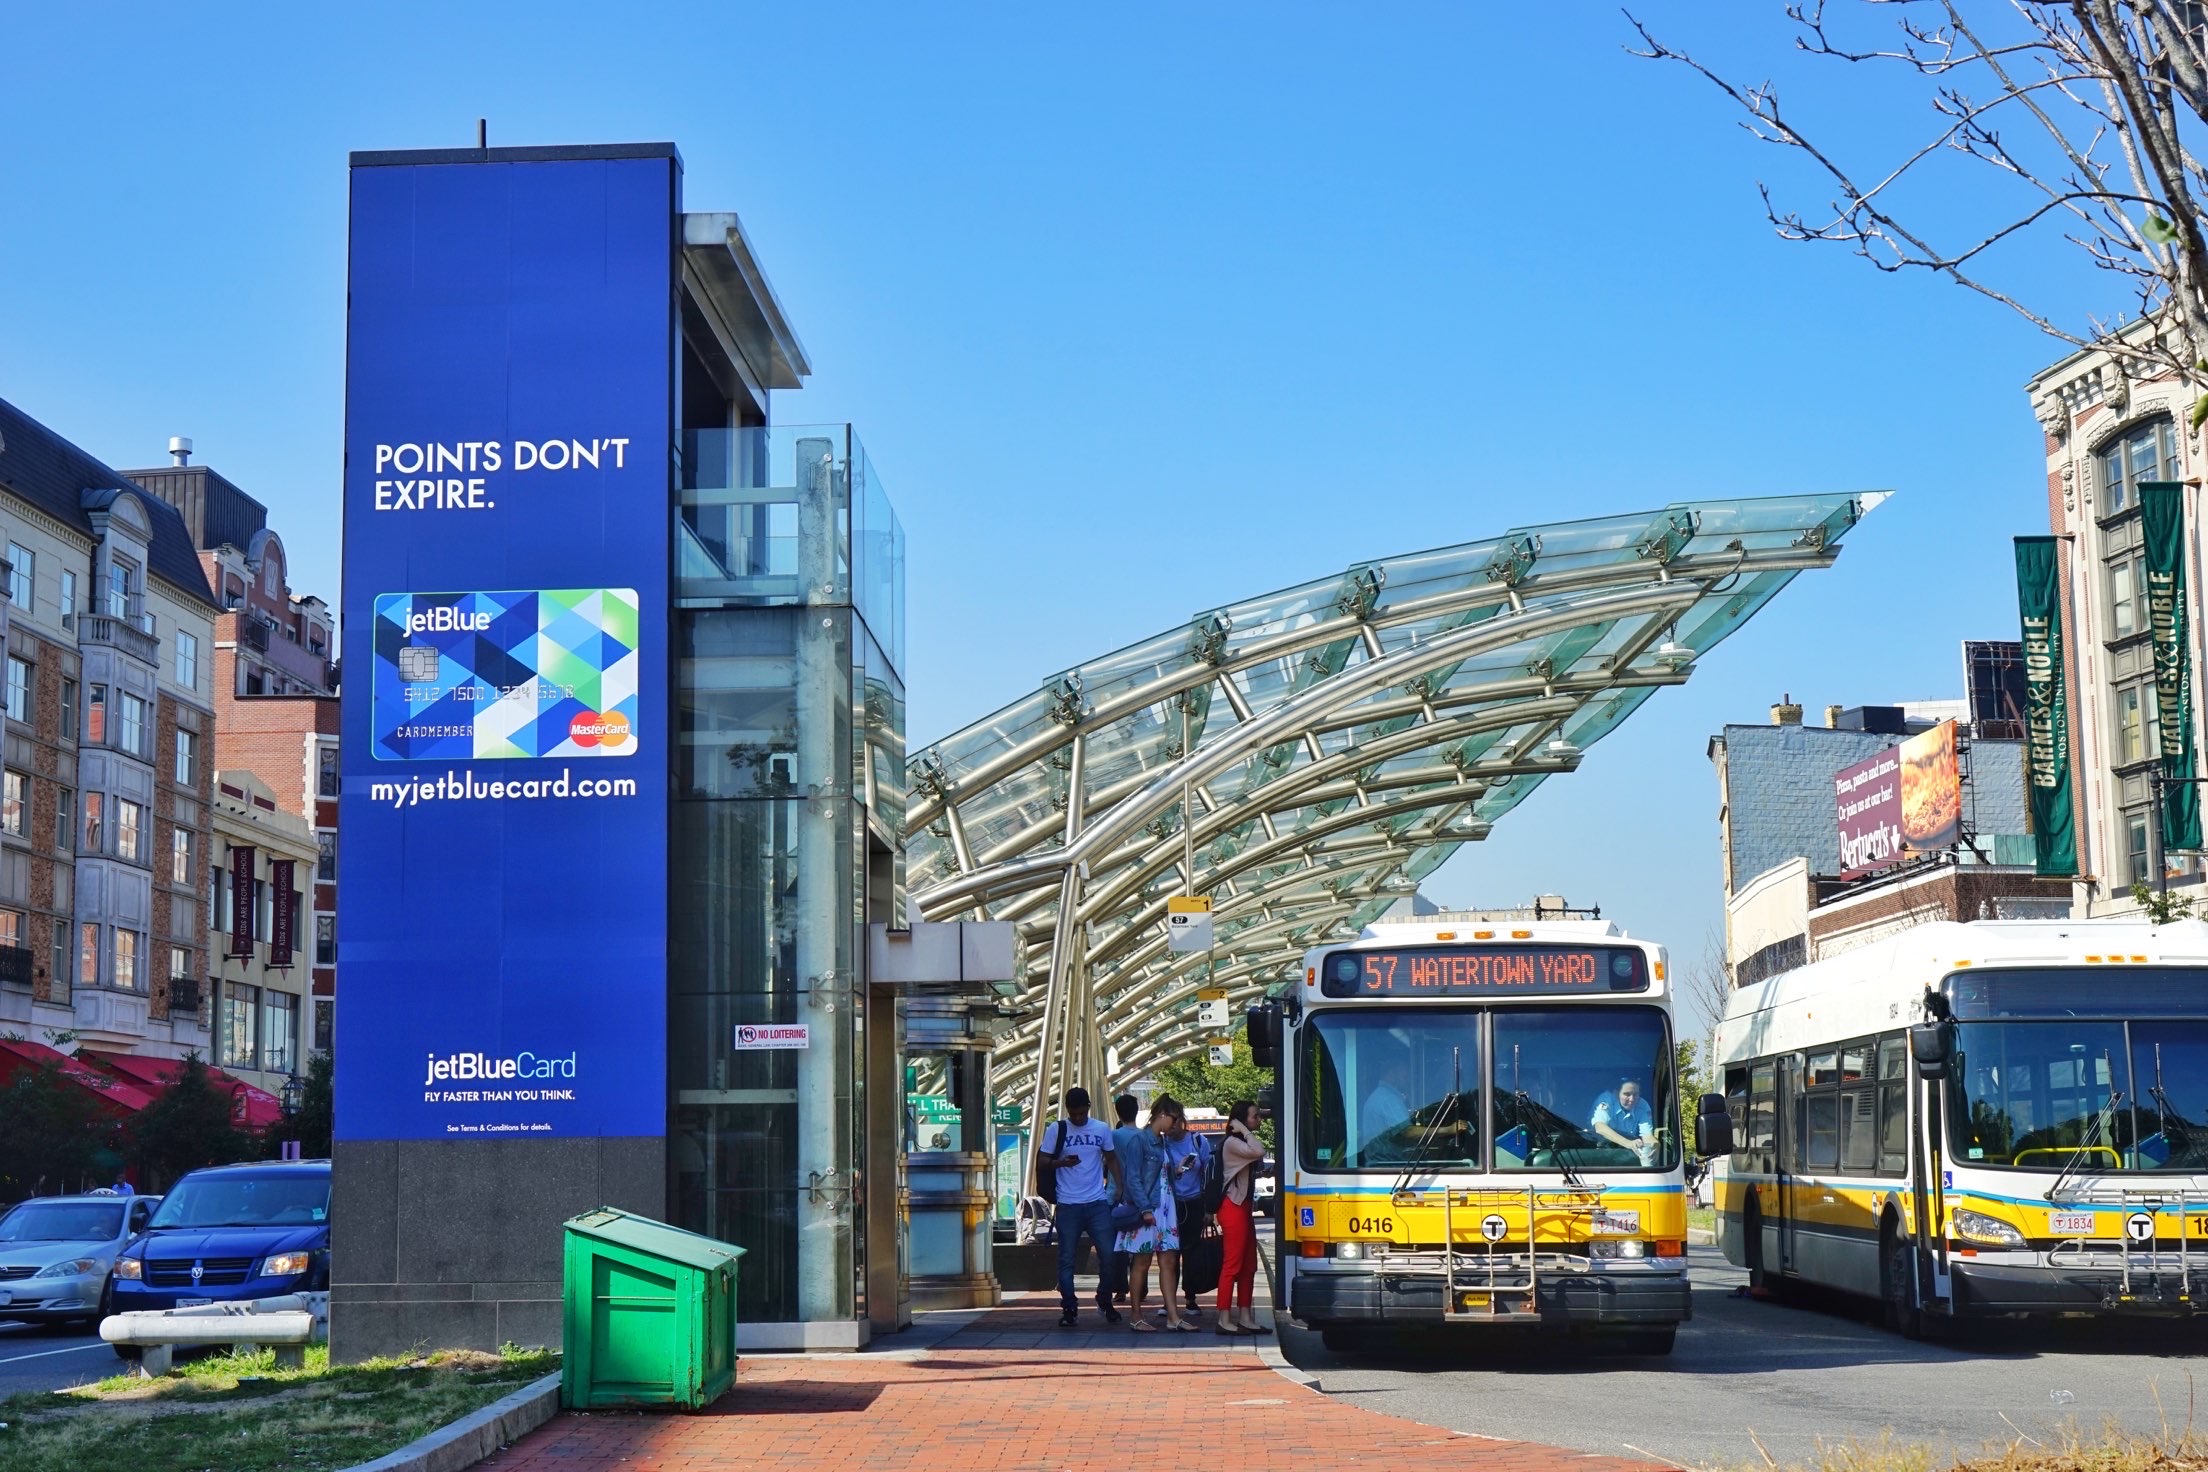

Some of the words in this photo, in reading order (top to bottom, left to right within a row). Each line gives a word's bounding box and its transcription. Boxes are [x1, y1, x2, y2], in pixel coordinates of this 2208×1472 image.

[375, 441, 502, 474] POINTS
[514, 438, 630, 471] DON'T
[375, 478, 495, 510] EXPIRE.
[403, 606, 491, 638] jetBlue
[2052, 632, 2065, 707] UNIVERSITY
[404, 687, 440, 702] 5412
[450, 686, 485, 701] 7500
[397, 725, 473, 738] CARDMEMBER
[570, 723, 630, 736] MasterCard
[2057, 710, 2067, 759] BOSTON
[1868, 760, 1879, 780] and
[371, 769, 636, 808] myjetbluecard.com
[1839, 805, 1846, 821] Or
[1857, 800, 1865, 813] us
[1864, 794, 1871, 810] at
[1203, 900, 1209, 911] 1
[1365, 956, 1398, 989] 57
[1411, 955, 1535, 987] WATERTOWN
[1540, 954, 1596, 984] YARD
[1219, 990, 1225, 998] 2
[758, 1030, 768, 1039] NO
[770, 1029, 806, 1039] LOITERING
[425, 1051, 576, 1086] jetBlueCard
[425, 1092, 440, 1102] FLY
[443, 1091, 480, 1102] FASTER
[482, 1090, 512, 1101] THAN
[515, 1090, 538, 1101] YOU
[541, 1089, 576, 1100] THINK.
[447, 1124, 459, 1132] See
[460, 1124, 478, 1132] Terms
[486, 1123, 519, 1131] Conditions
[520, 1122, 529, 1131] for
[531, 1122, 553, 1131] details.
[1065, 1134, 1103, 1148] YALE
[1349, 1217, 1393, 1233] 0416
[1485, 1221, 1503, 1237] T
[2067, 1217, 2093, 1229] 1834
[2131, 1220, 2150, 1237] T
